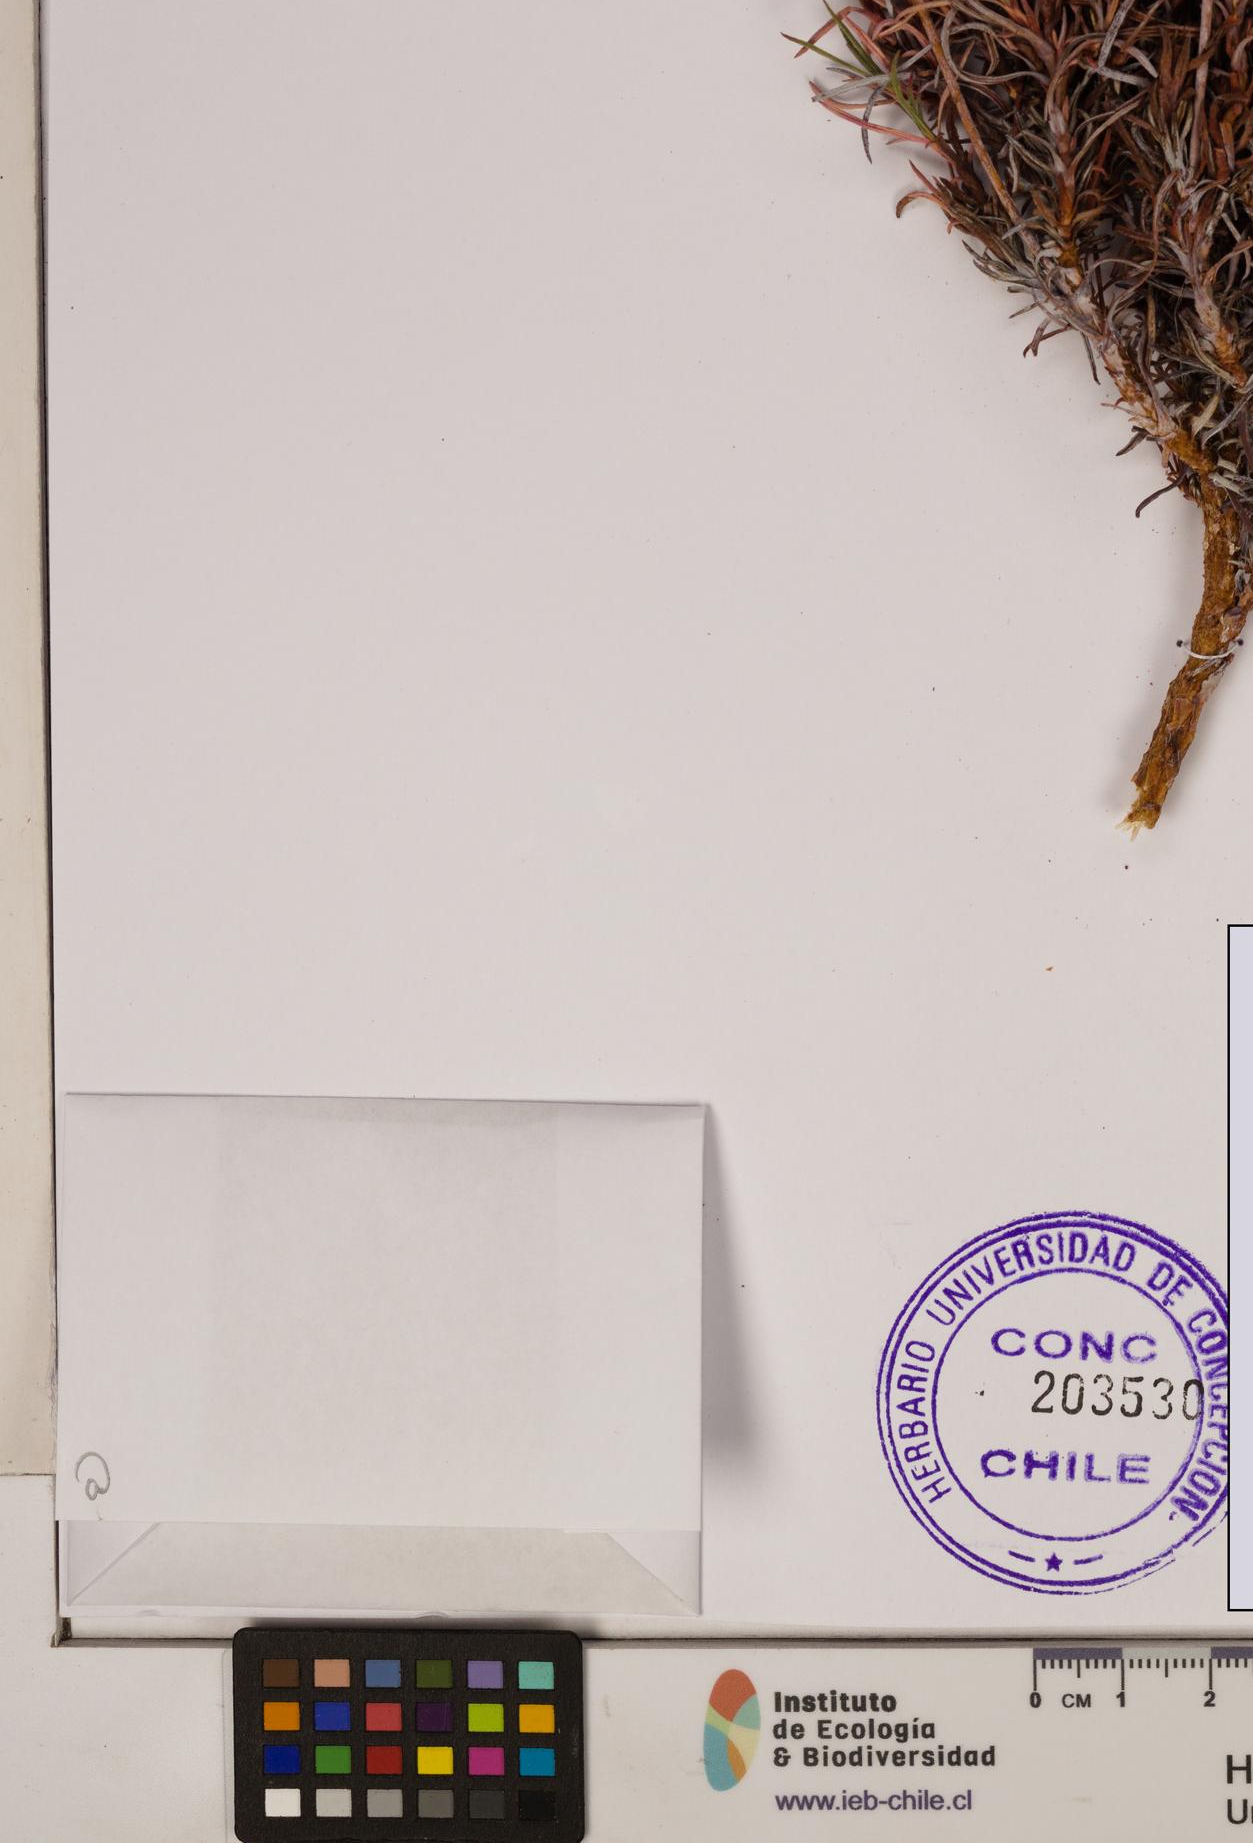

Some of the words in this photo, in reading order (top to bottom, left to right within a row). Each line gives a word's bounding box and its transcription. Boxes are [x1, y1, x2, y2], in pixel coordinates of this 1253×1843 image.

[990, 1328, 1158, 1364] CONC
[896, 1340, 952, 1503] HERBARIO
[926, 1231, 1137, 1326] UNIVERSIDAD
[1146, 1260, 1194, 1307] DE
[1030, 1370, 1204, 1421] 203530
[980, 1449, 1152, 1485] CHILE
[773, 1690, 898, 1714] Instituto
[1029, 1691, 1042, 1709] 0
[1061, 1693, 1092, 1709] CM
[1115, 1691, 1126, 1708] 1
[1203, 1690, 1216, 1708] 2
[772, 1717, 806, 1741] de
[817, 1717, 936, 1744] Ecología
[773, 1746, 792, 1768] &
[802, 1744, 996, 1768] Biodiversidad
[774, 1789, 972, 1812] www.ieb-chile.cl
